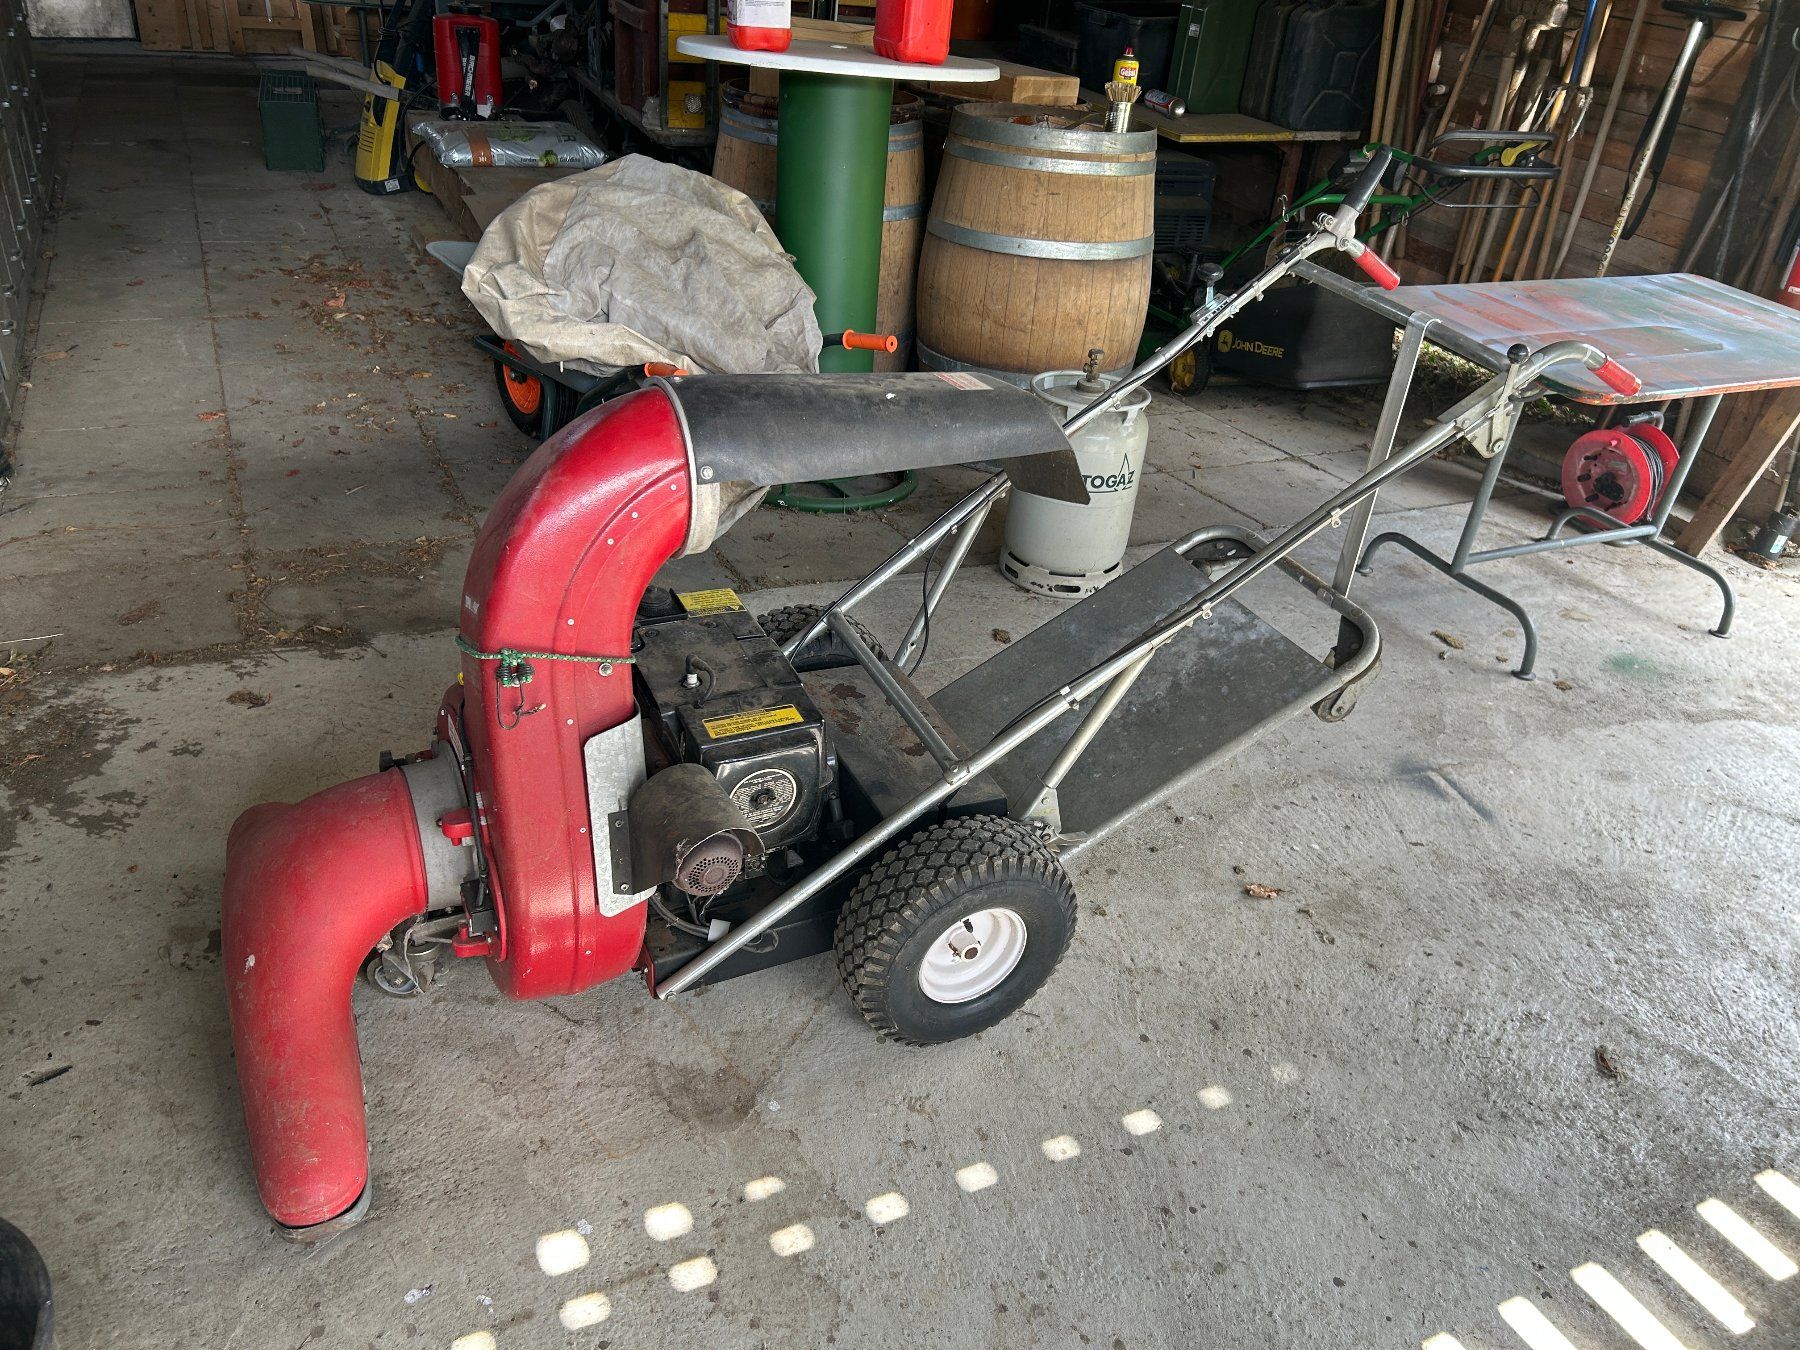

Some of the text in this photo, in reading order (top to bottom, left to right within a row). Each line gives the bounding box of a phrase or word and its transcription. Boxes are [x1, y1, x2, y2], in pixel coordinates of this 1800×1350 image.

[1232, 338, 1285, 358] JOHN DEERE
[1082, 470, 1135, 489] TOGAZ
